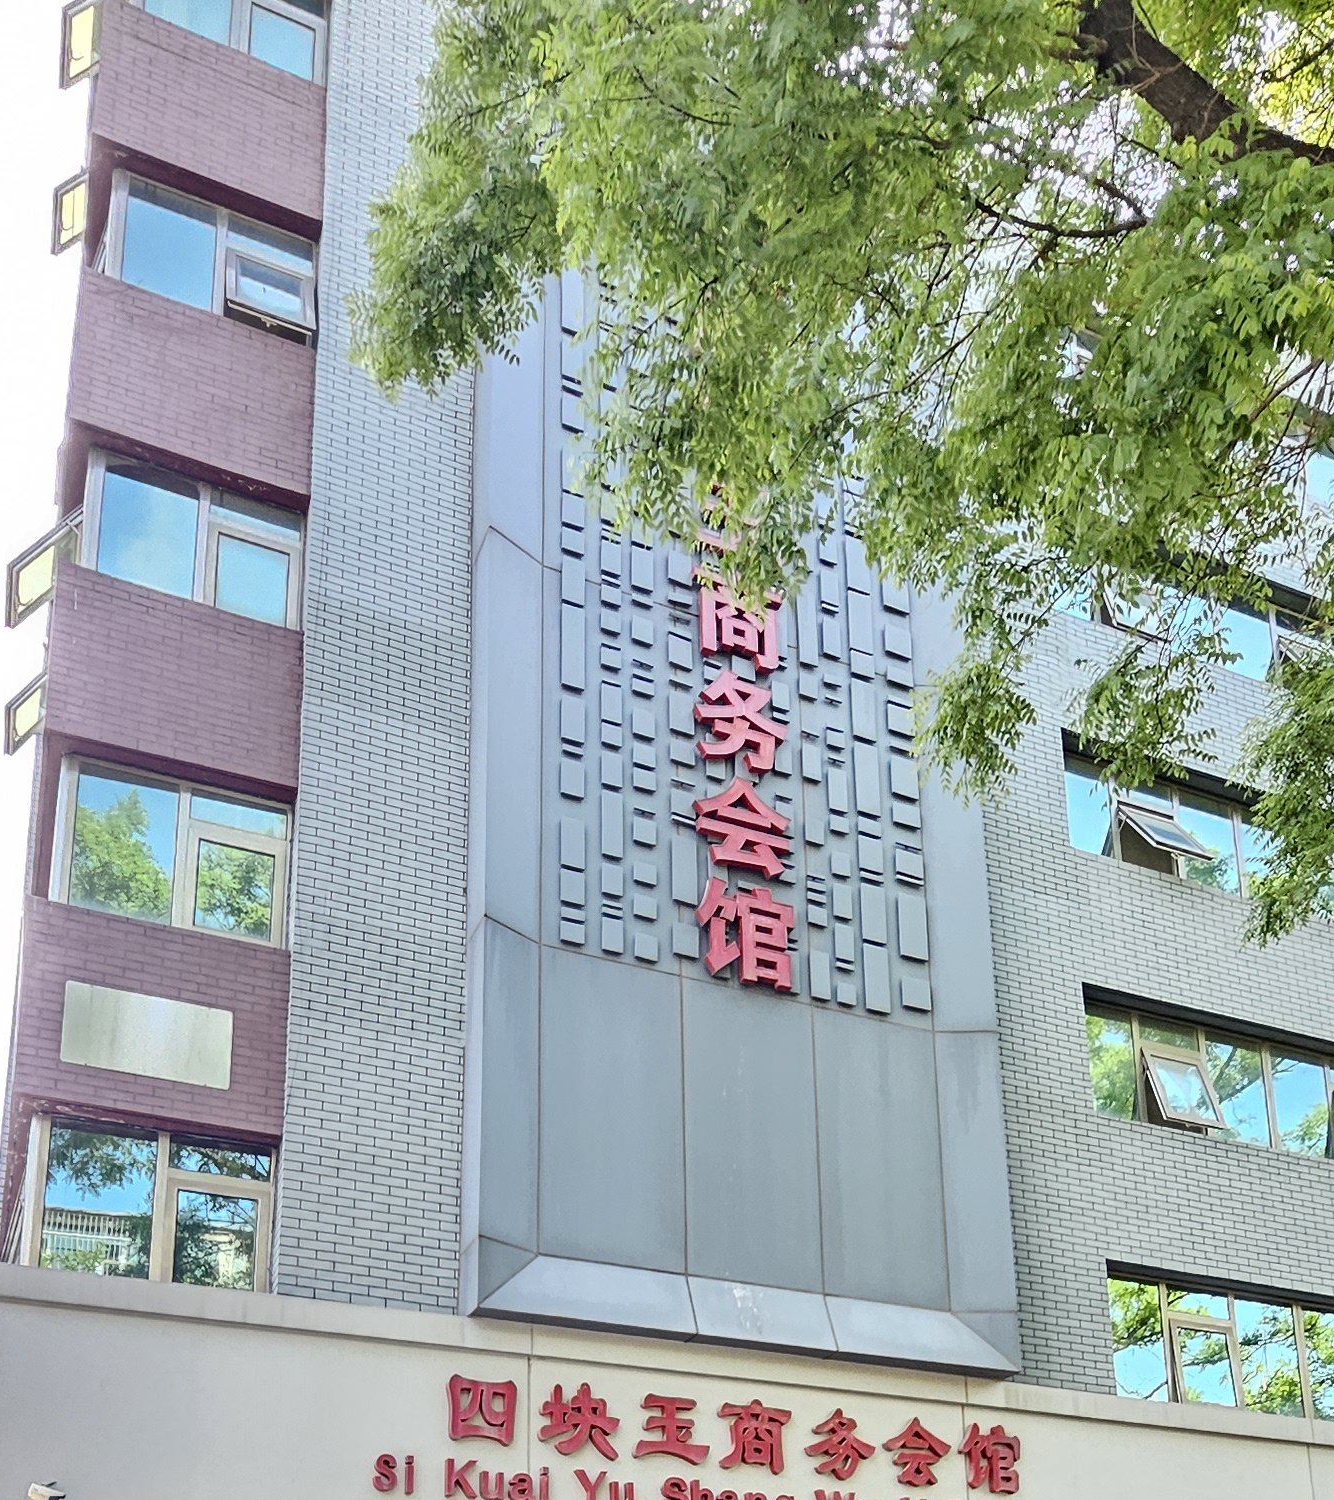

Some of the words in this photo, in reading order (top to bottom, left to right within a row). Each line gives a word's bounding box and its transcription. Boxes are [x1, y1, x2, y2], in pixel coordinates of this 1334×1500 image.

[372, 1454, 415, 1495] Si
[447, 1373, 1021, 1495] 四块玉商务会馆
